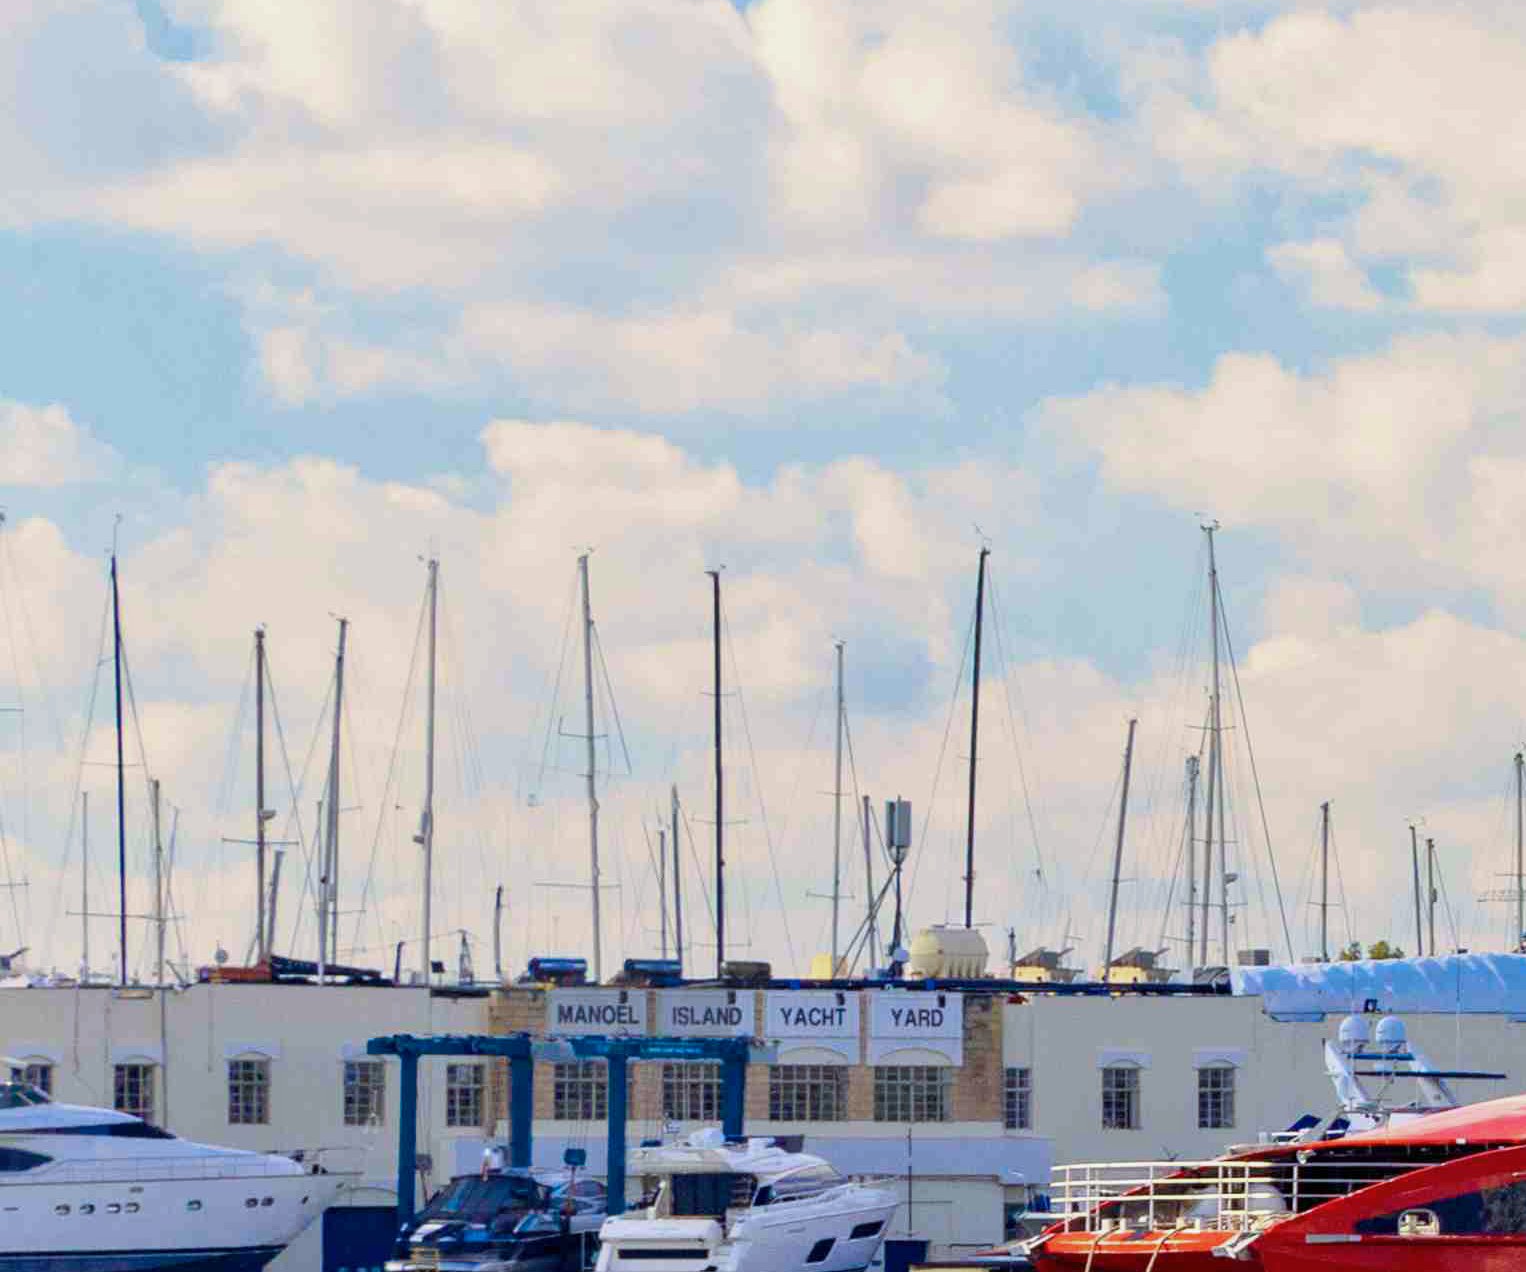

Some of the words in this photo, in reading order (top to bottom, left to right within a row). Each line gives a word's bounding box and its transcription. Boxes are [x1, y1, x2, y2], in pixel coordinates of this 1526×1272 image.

[557, 1004, 640, 1025] MANOEL
[671, 1006, 743, 1026] ISLAND
[780, 1007, 848, 1027] YACHT
[890, 1008, 944, 1028] YARD
